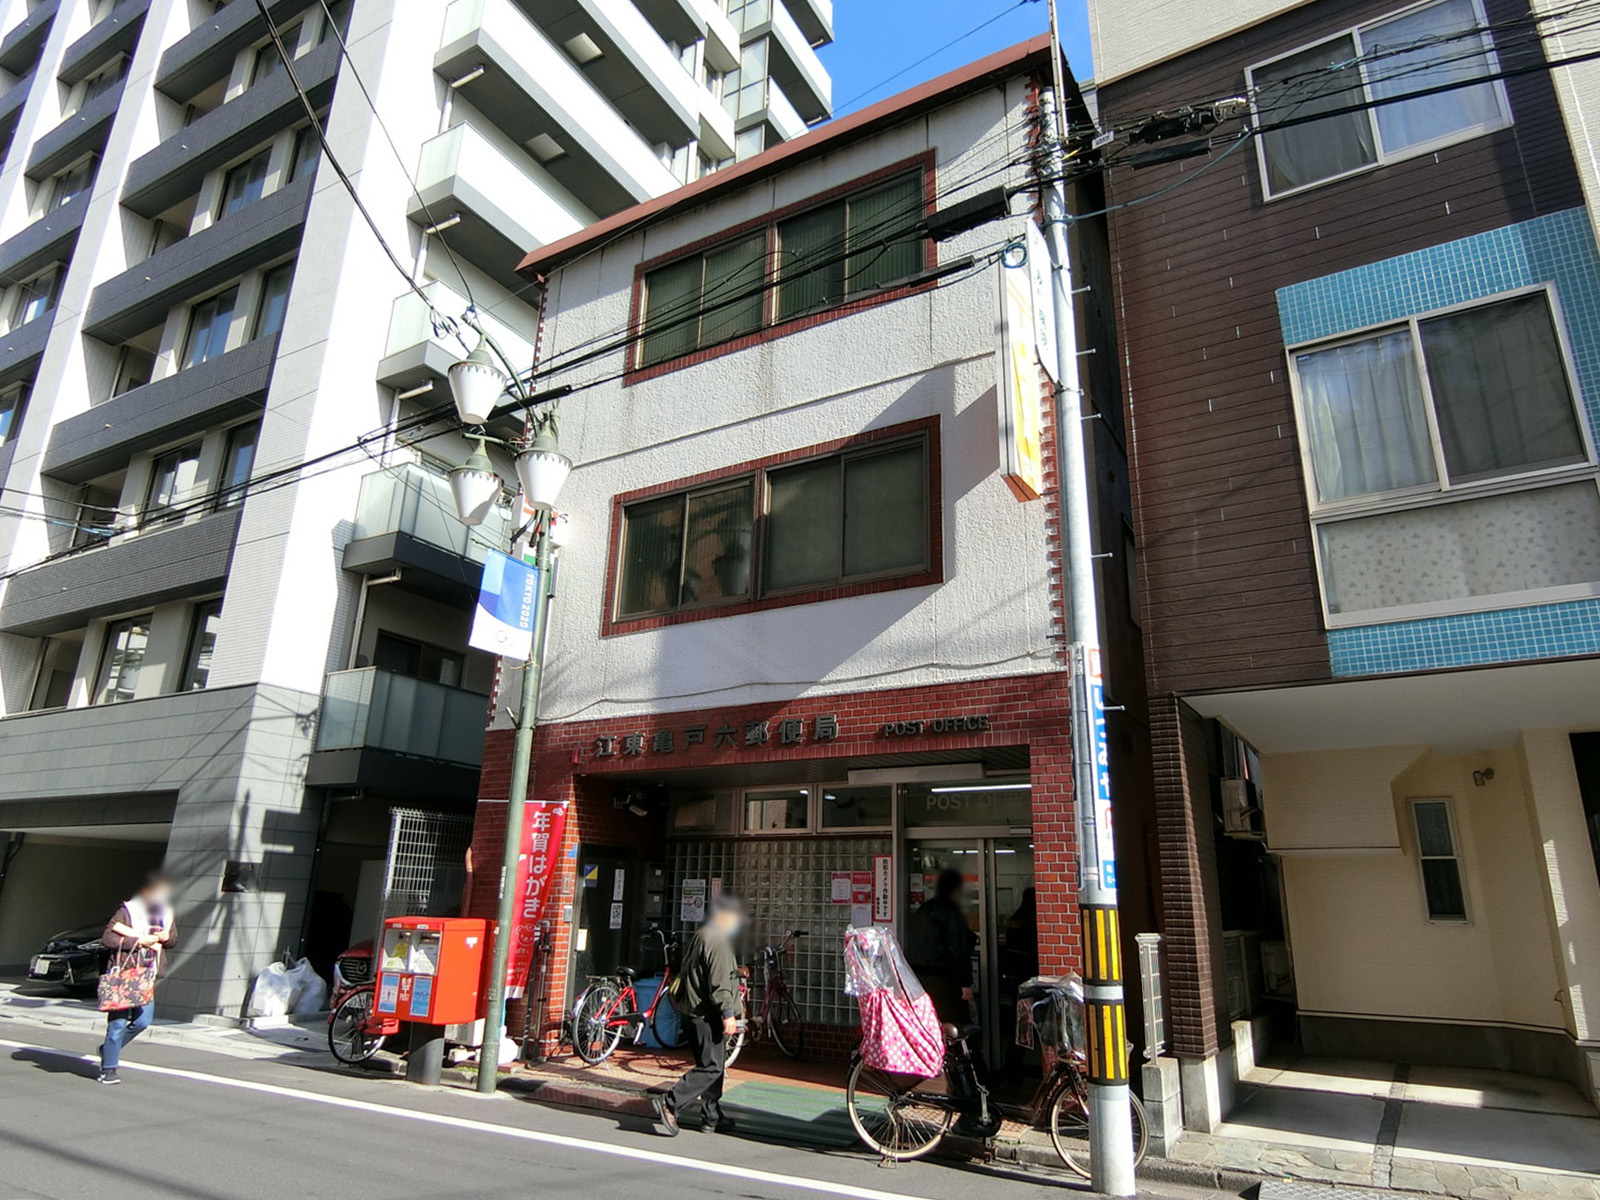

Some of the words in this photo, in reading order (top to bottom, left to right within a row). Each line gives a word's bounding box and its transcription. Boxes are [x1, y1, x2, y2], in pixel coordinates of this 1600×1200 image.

[523, 574, 534, 604] TOKYO
[520, 605, 531, 628] 2020
[596, 713, 839, 758] 江東亀戸六郵便局
[884, 719, 927, 737] POST
[933, 714, 991, 734] OFFICE
[926, 793, 972, 811] POST
[523, 810, 551, 919] 年賀はがき
